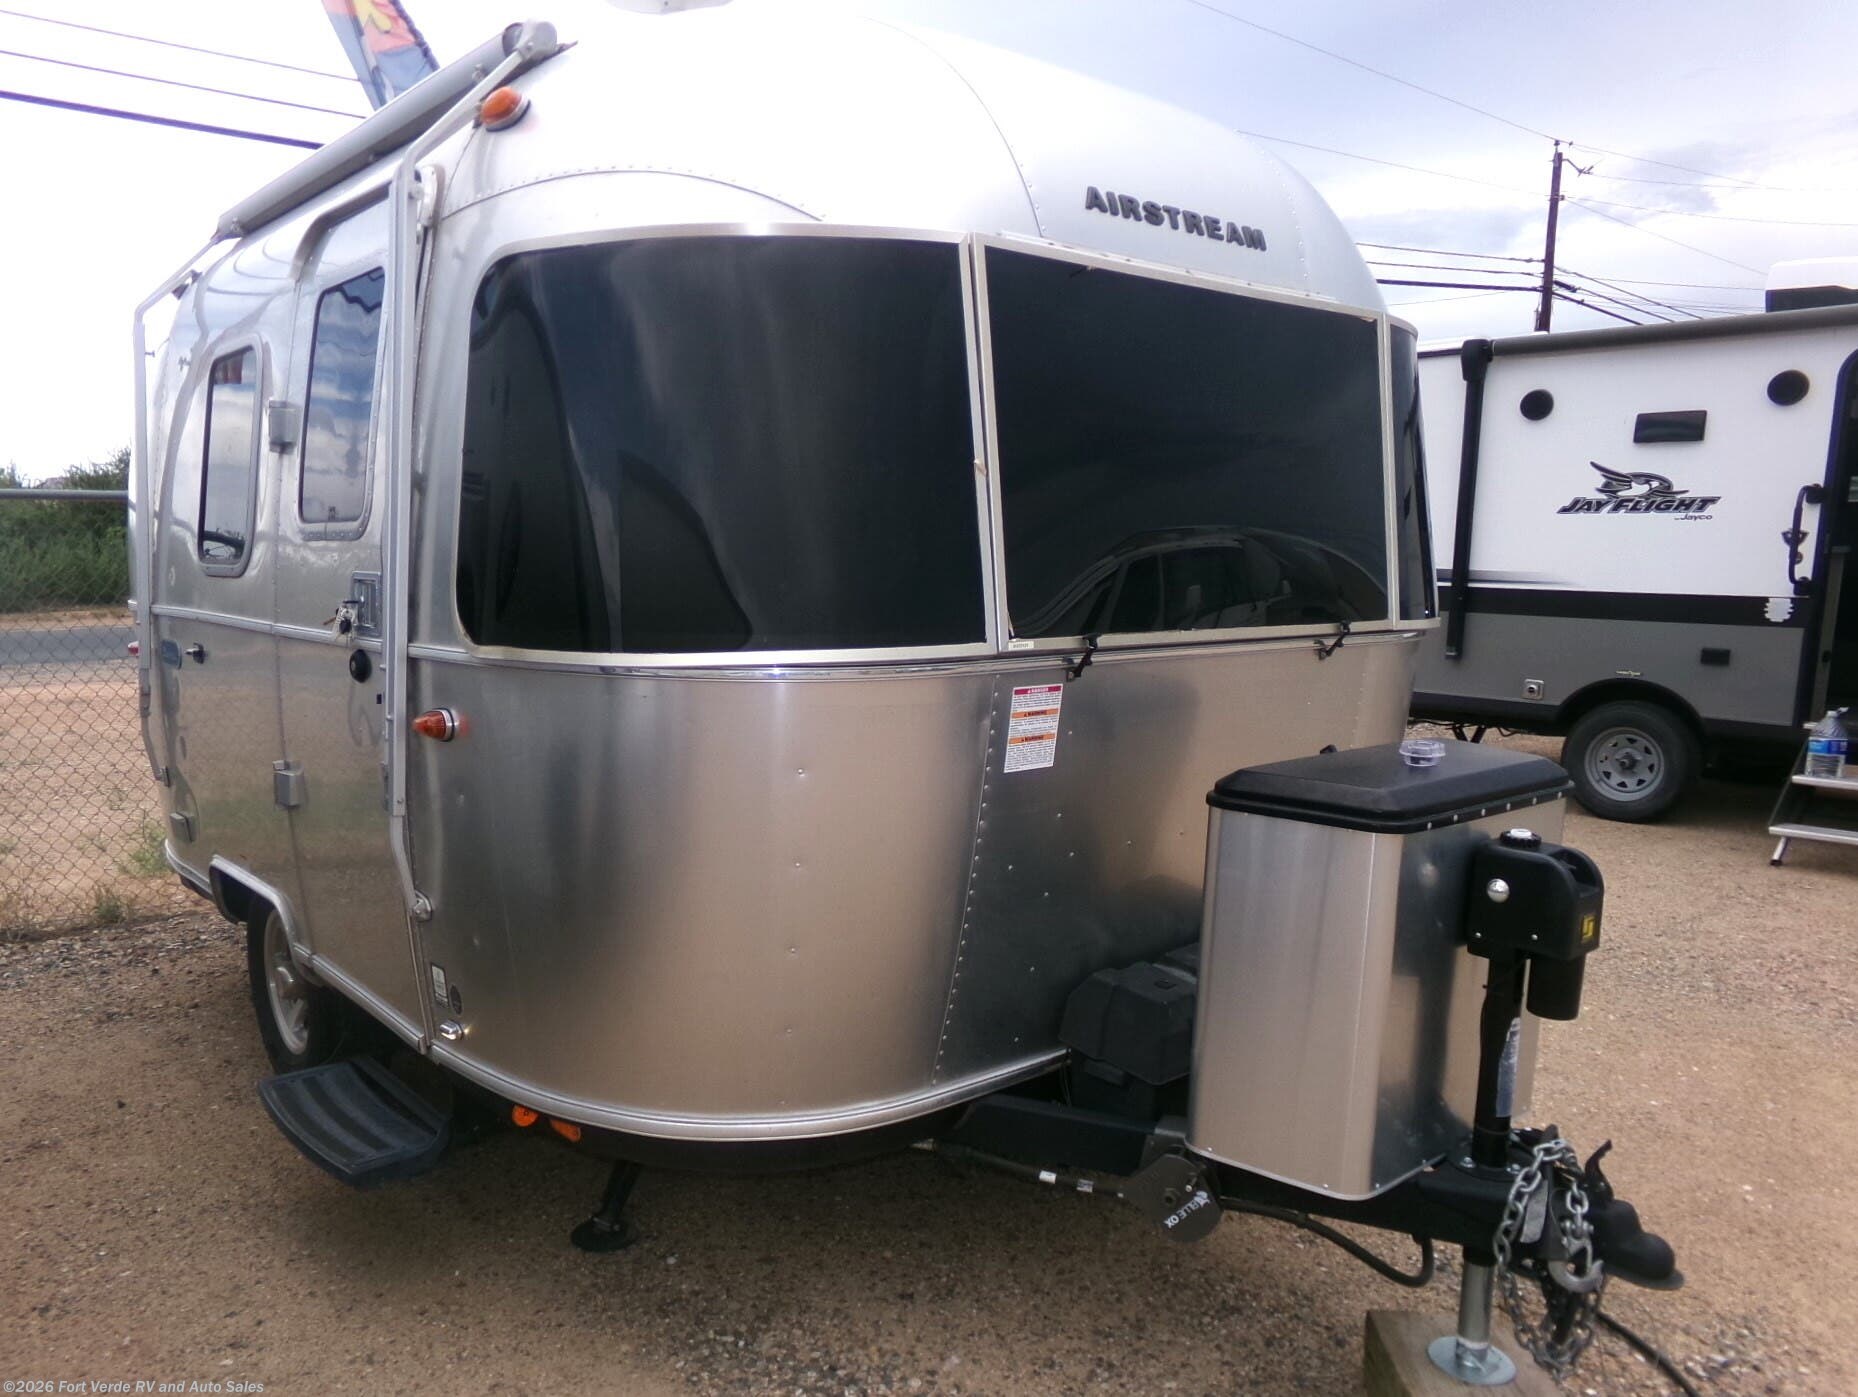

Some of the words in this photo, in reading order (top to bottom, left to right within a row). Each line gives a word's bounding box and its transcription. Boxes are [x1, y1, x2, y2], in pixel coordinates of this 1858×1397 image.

[1085, 185, 1267, 252] AIRSTREAM
[1556, 497, 1615, 514] JAY
[1607, 496, 1722, 513] FLIGHT
[1176, 1200, 1200, 1220] BLUE
[1163, 1215, 1180, 1229] OX
